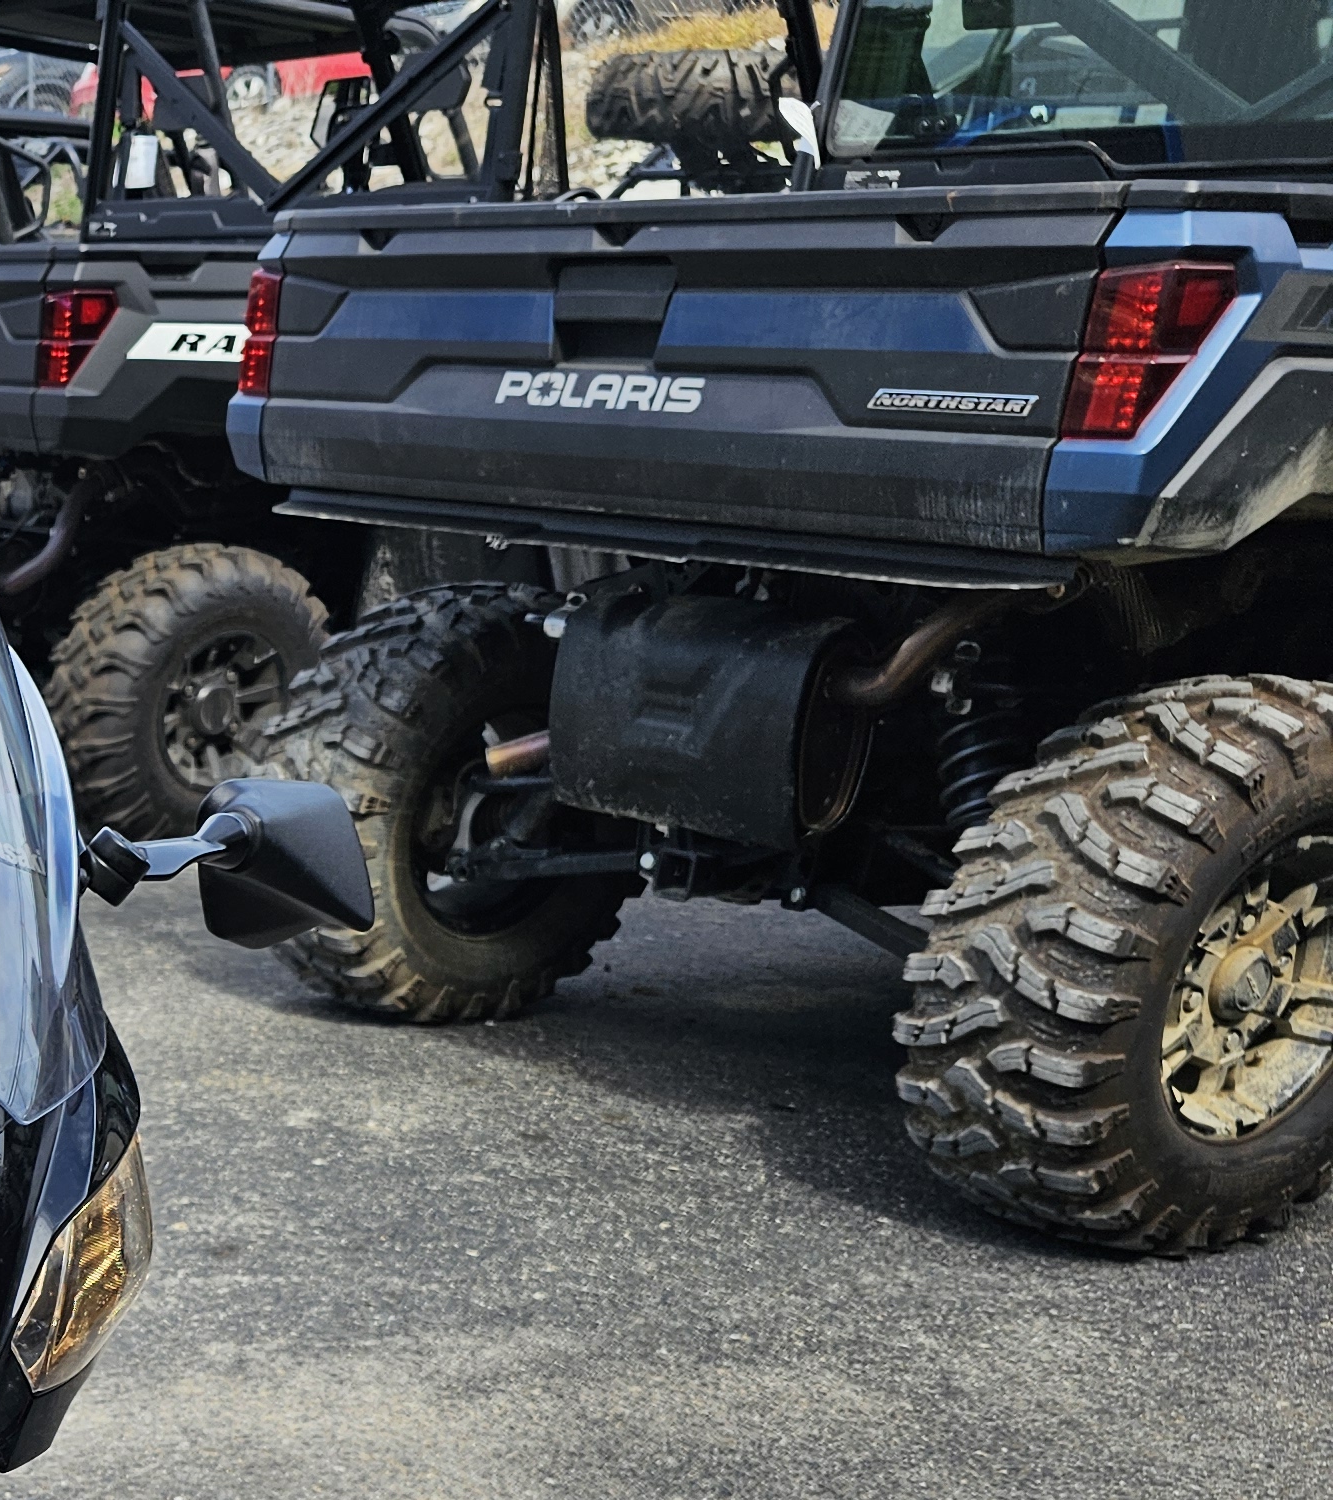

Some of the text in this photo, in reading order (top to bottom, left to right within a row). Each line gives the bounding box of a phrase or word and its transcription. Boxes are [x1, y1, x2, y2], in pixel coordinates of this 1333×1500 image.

[169, 333, 245, 355] RA
[494, 370, 706, 413] POLARIS
[875, 393, 1027, 413] NORTHSTAR
